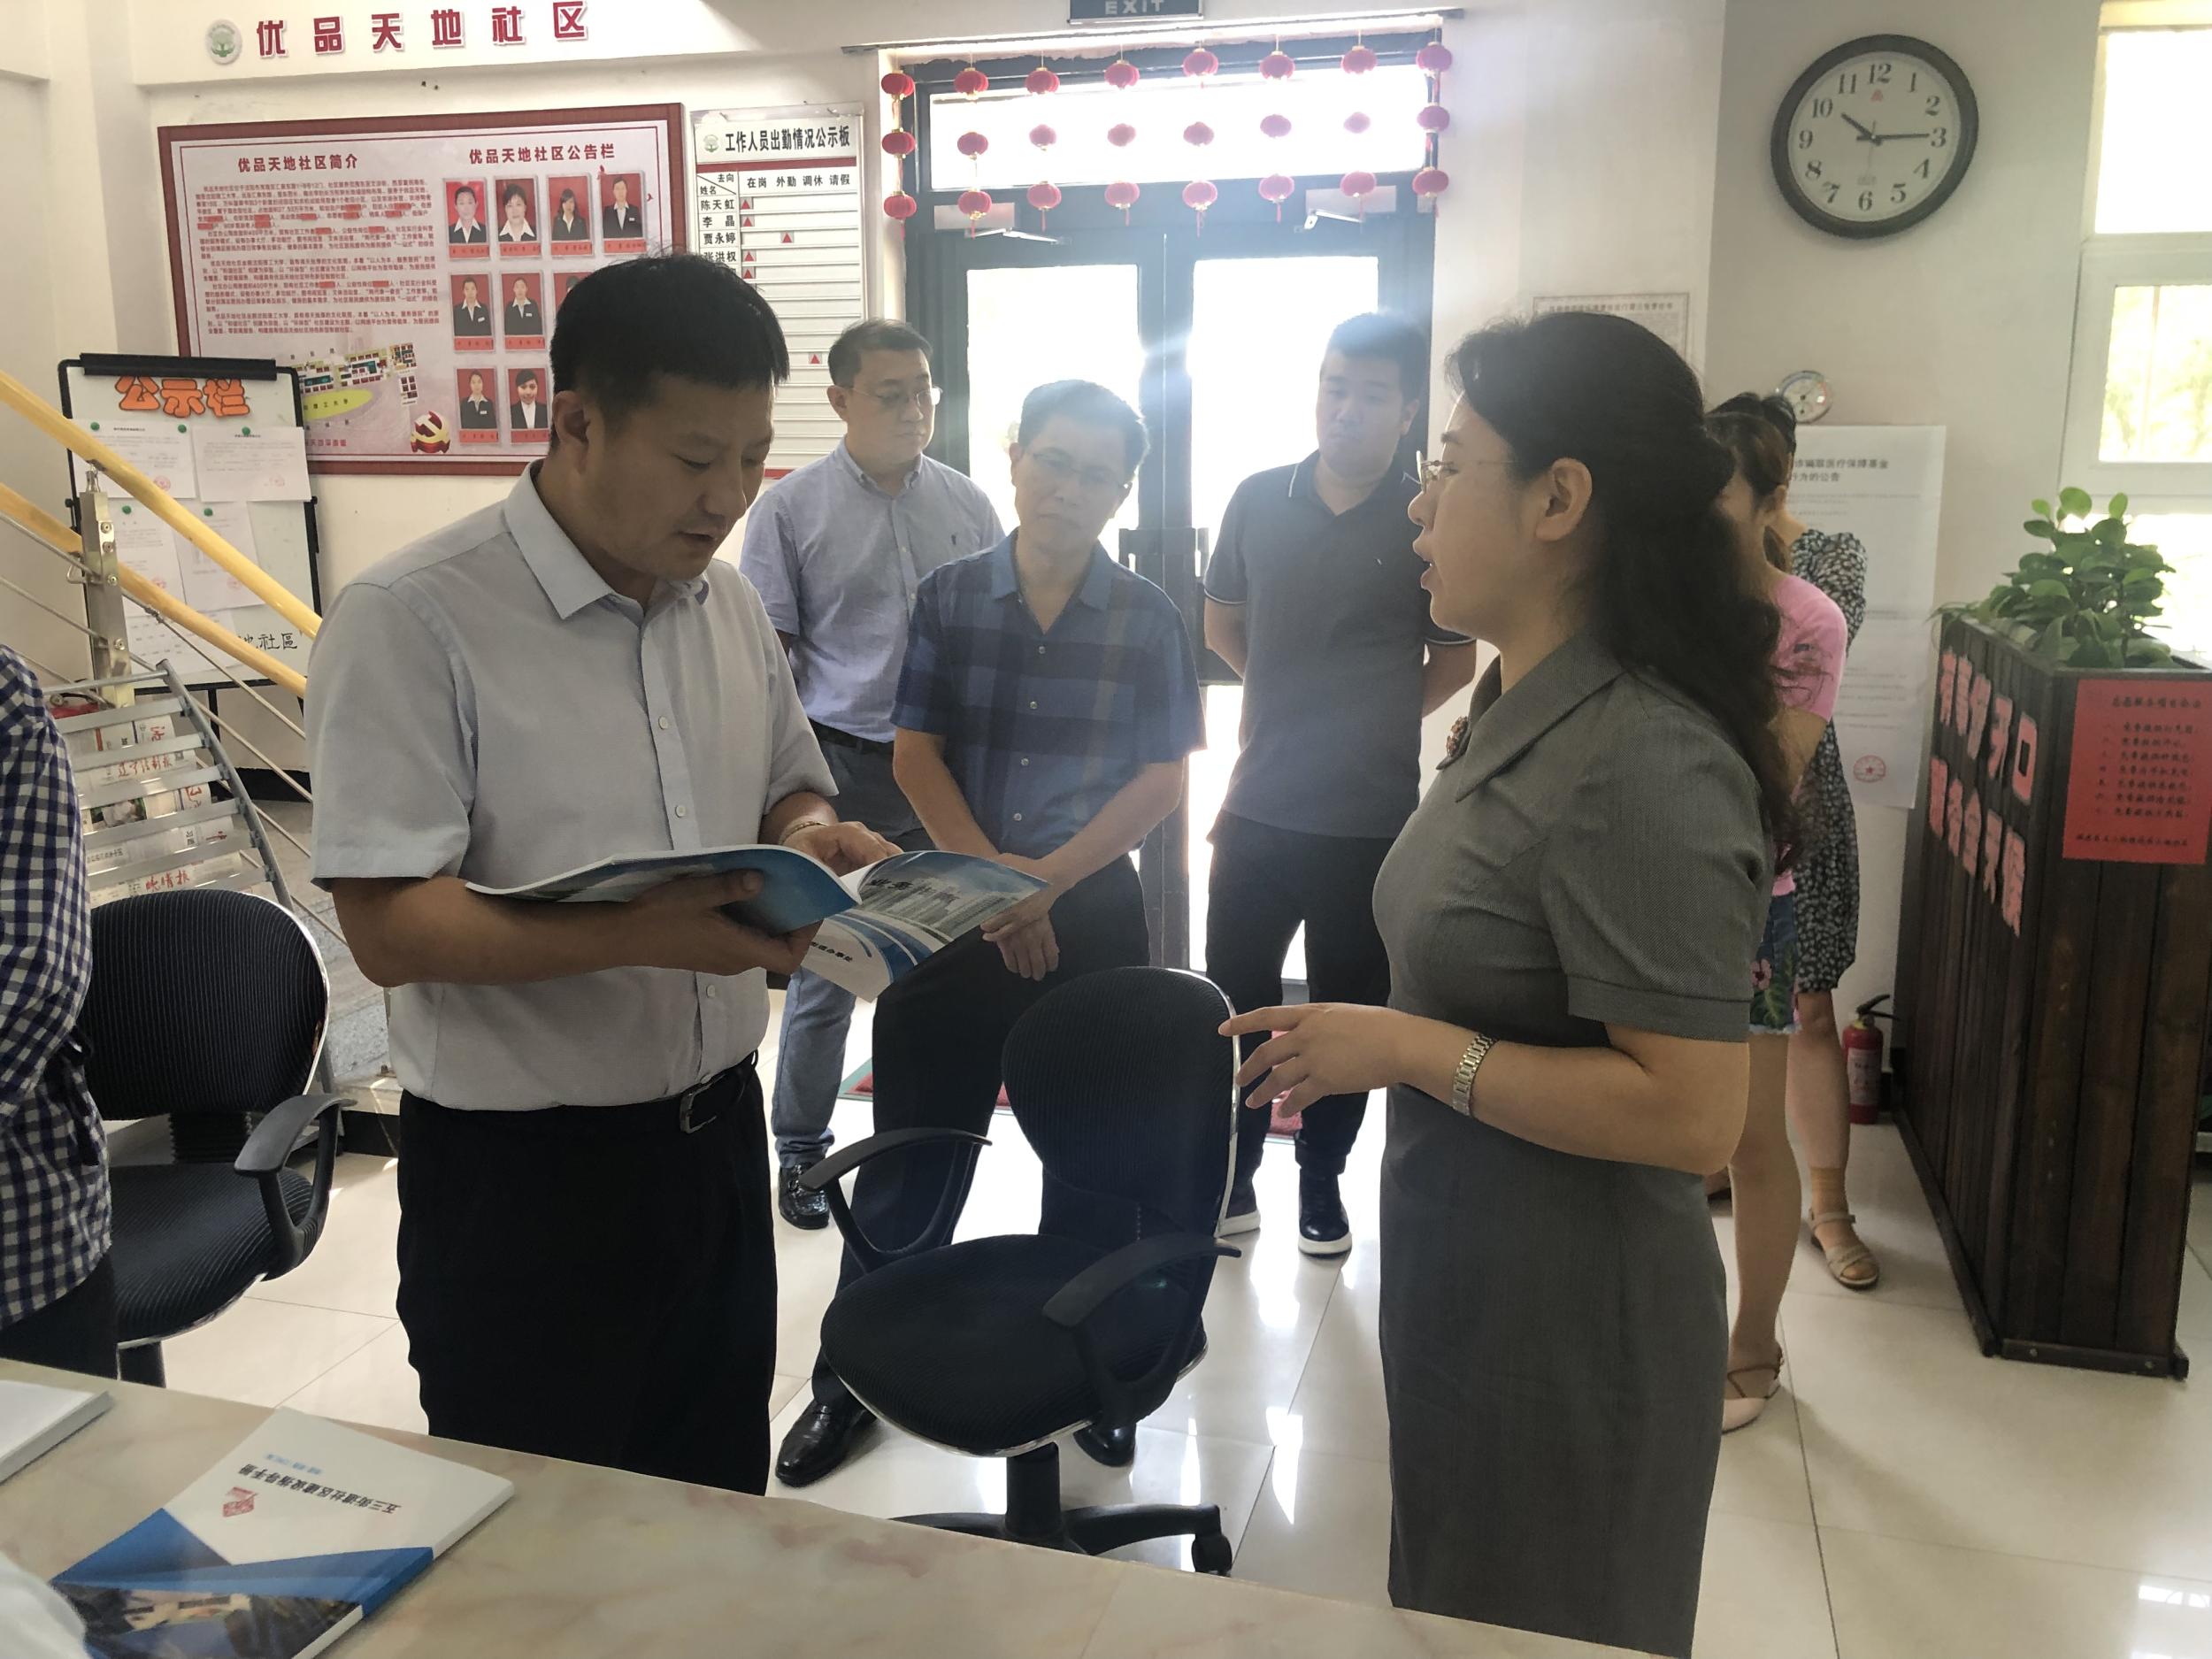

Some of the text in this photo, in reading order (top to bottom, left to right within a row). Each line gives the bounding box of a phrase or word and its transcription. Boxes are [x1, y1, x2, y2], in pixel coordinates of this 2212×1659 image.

[1106, 0, 1164, 15] EXIT
[256, 1, 588, 58] 优品天地社区
[1838, 73, 1857, 94] 11
[1869, 63, 1892, 84] 12
[1908, 72, 1917, 93] 1
[1811, 97, 1833, 119] 10
[1924, 95, 1940, 116] 2
[725, 125, 850, 153] 工作人员出勤情况公示板
[1798, 129, 1813, 150] 9
[1930, 127, 1947, 149] 3
[237, 153, 359, 173] 优品天地社区简介
[469, 142, 616, 165] 优品天地社区公告栏
[1804, 159, 1822, 180] 8
[1913, 157, 1930, 179] 4
[700, 185, 717, 196] 姓名
[747, 173, 850, 189] 在岗 外勤 调休 请假
[1822, 180, 1840, 204] 7
[1858, 190, 1873, 211] 6
[1890, 182, 1907, 203] 5
[701, 199, 734, 211] 陈天虹
[115, 374, 250, 419] 公示栏
